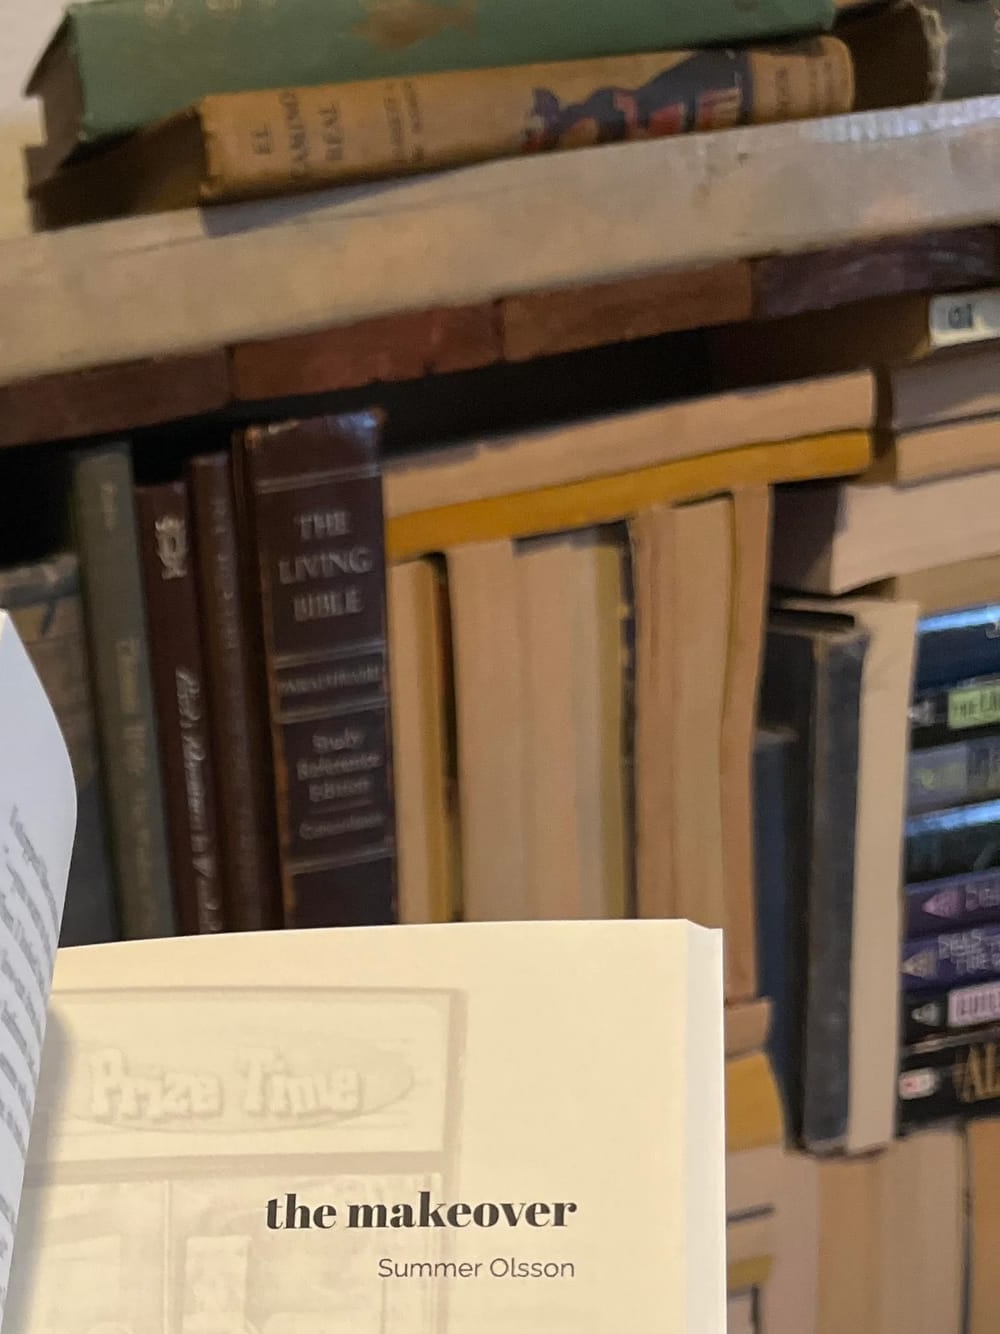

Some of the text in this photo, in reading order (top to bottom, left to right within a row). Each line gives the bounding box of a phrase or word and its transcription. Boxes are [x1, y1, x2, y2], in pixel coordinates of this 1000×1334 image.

[295, 510, 350, 541] THE
[278, 547, 374, 584] LIVING
[294, 588, 364, 622] BIBLE
[237, 1045, 366, 1117] Time
[265, 1190, 578, 1230] the makeover
[377, 1255, 576, 1280] Summer Olsson
